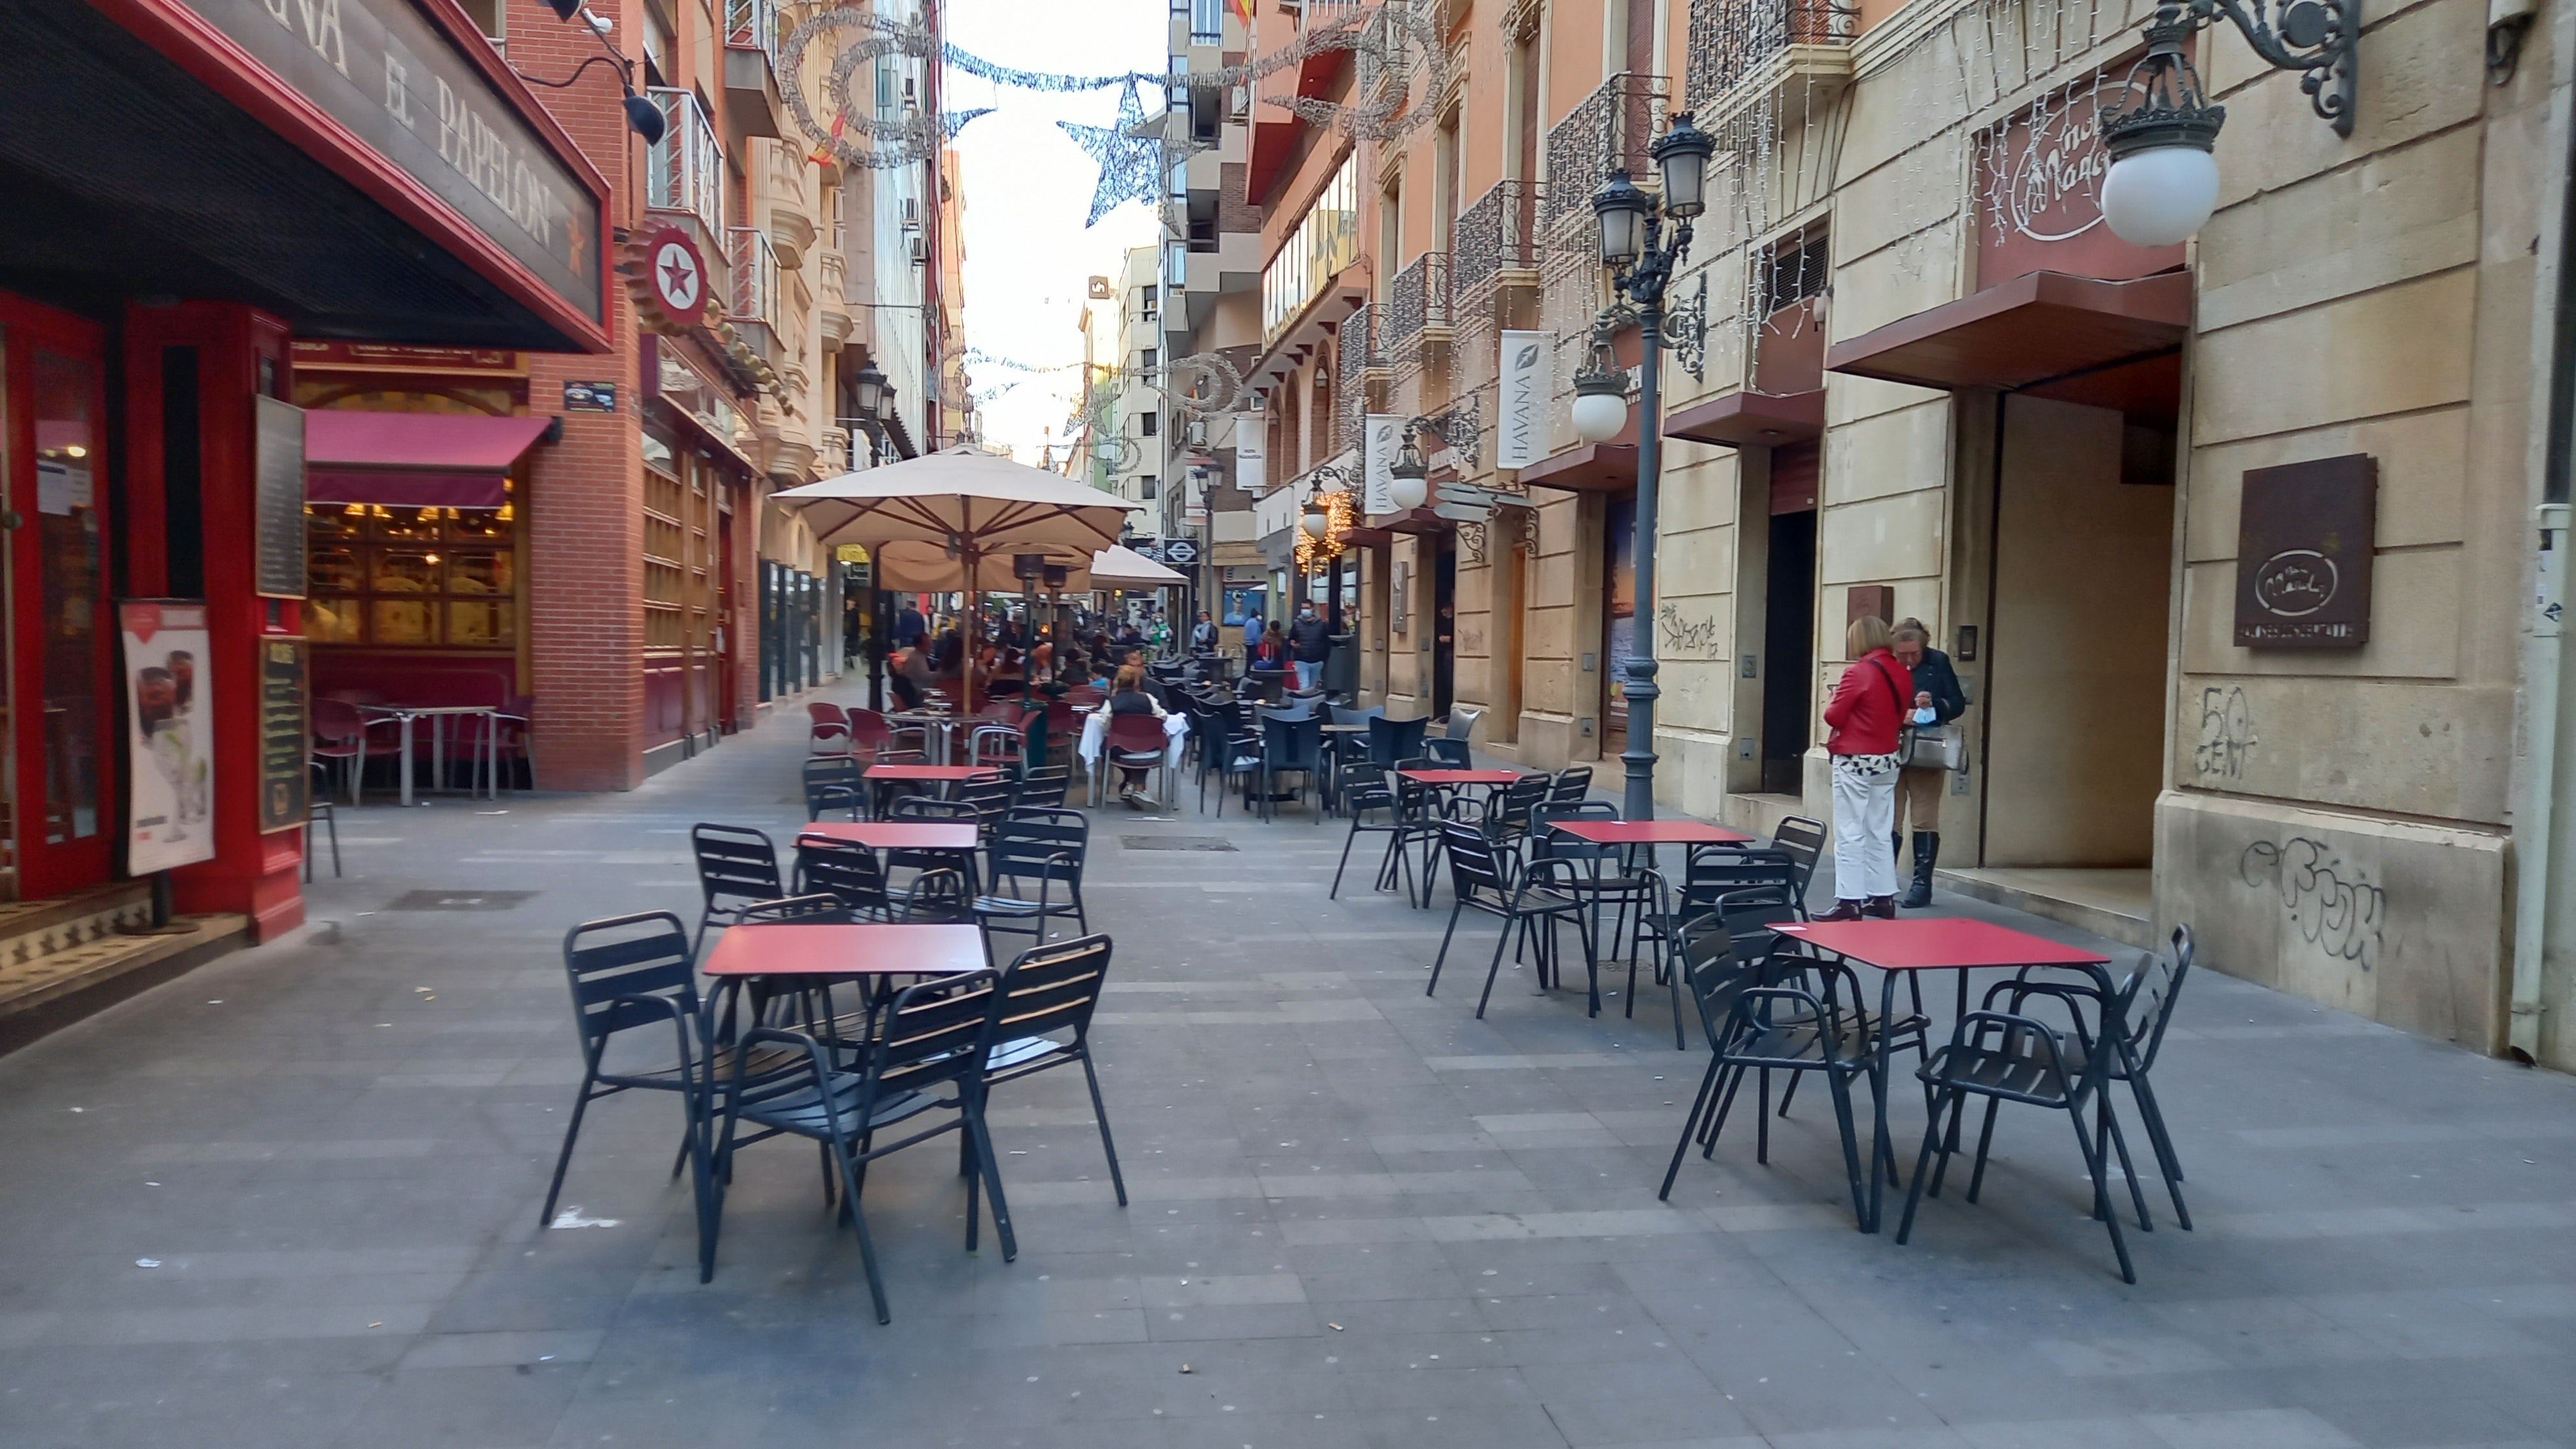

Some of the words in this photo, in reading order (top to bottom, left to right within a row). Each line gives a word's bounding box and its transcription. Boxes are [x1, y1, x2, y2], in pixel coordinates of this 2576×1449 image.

[384, 51, 414, 129] EL
[436, 76, 552, 251] PAPELÓN
[1511, 375, 1531, 459] HAVANA
[1376, 447, 1387, 507] HAVANA
